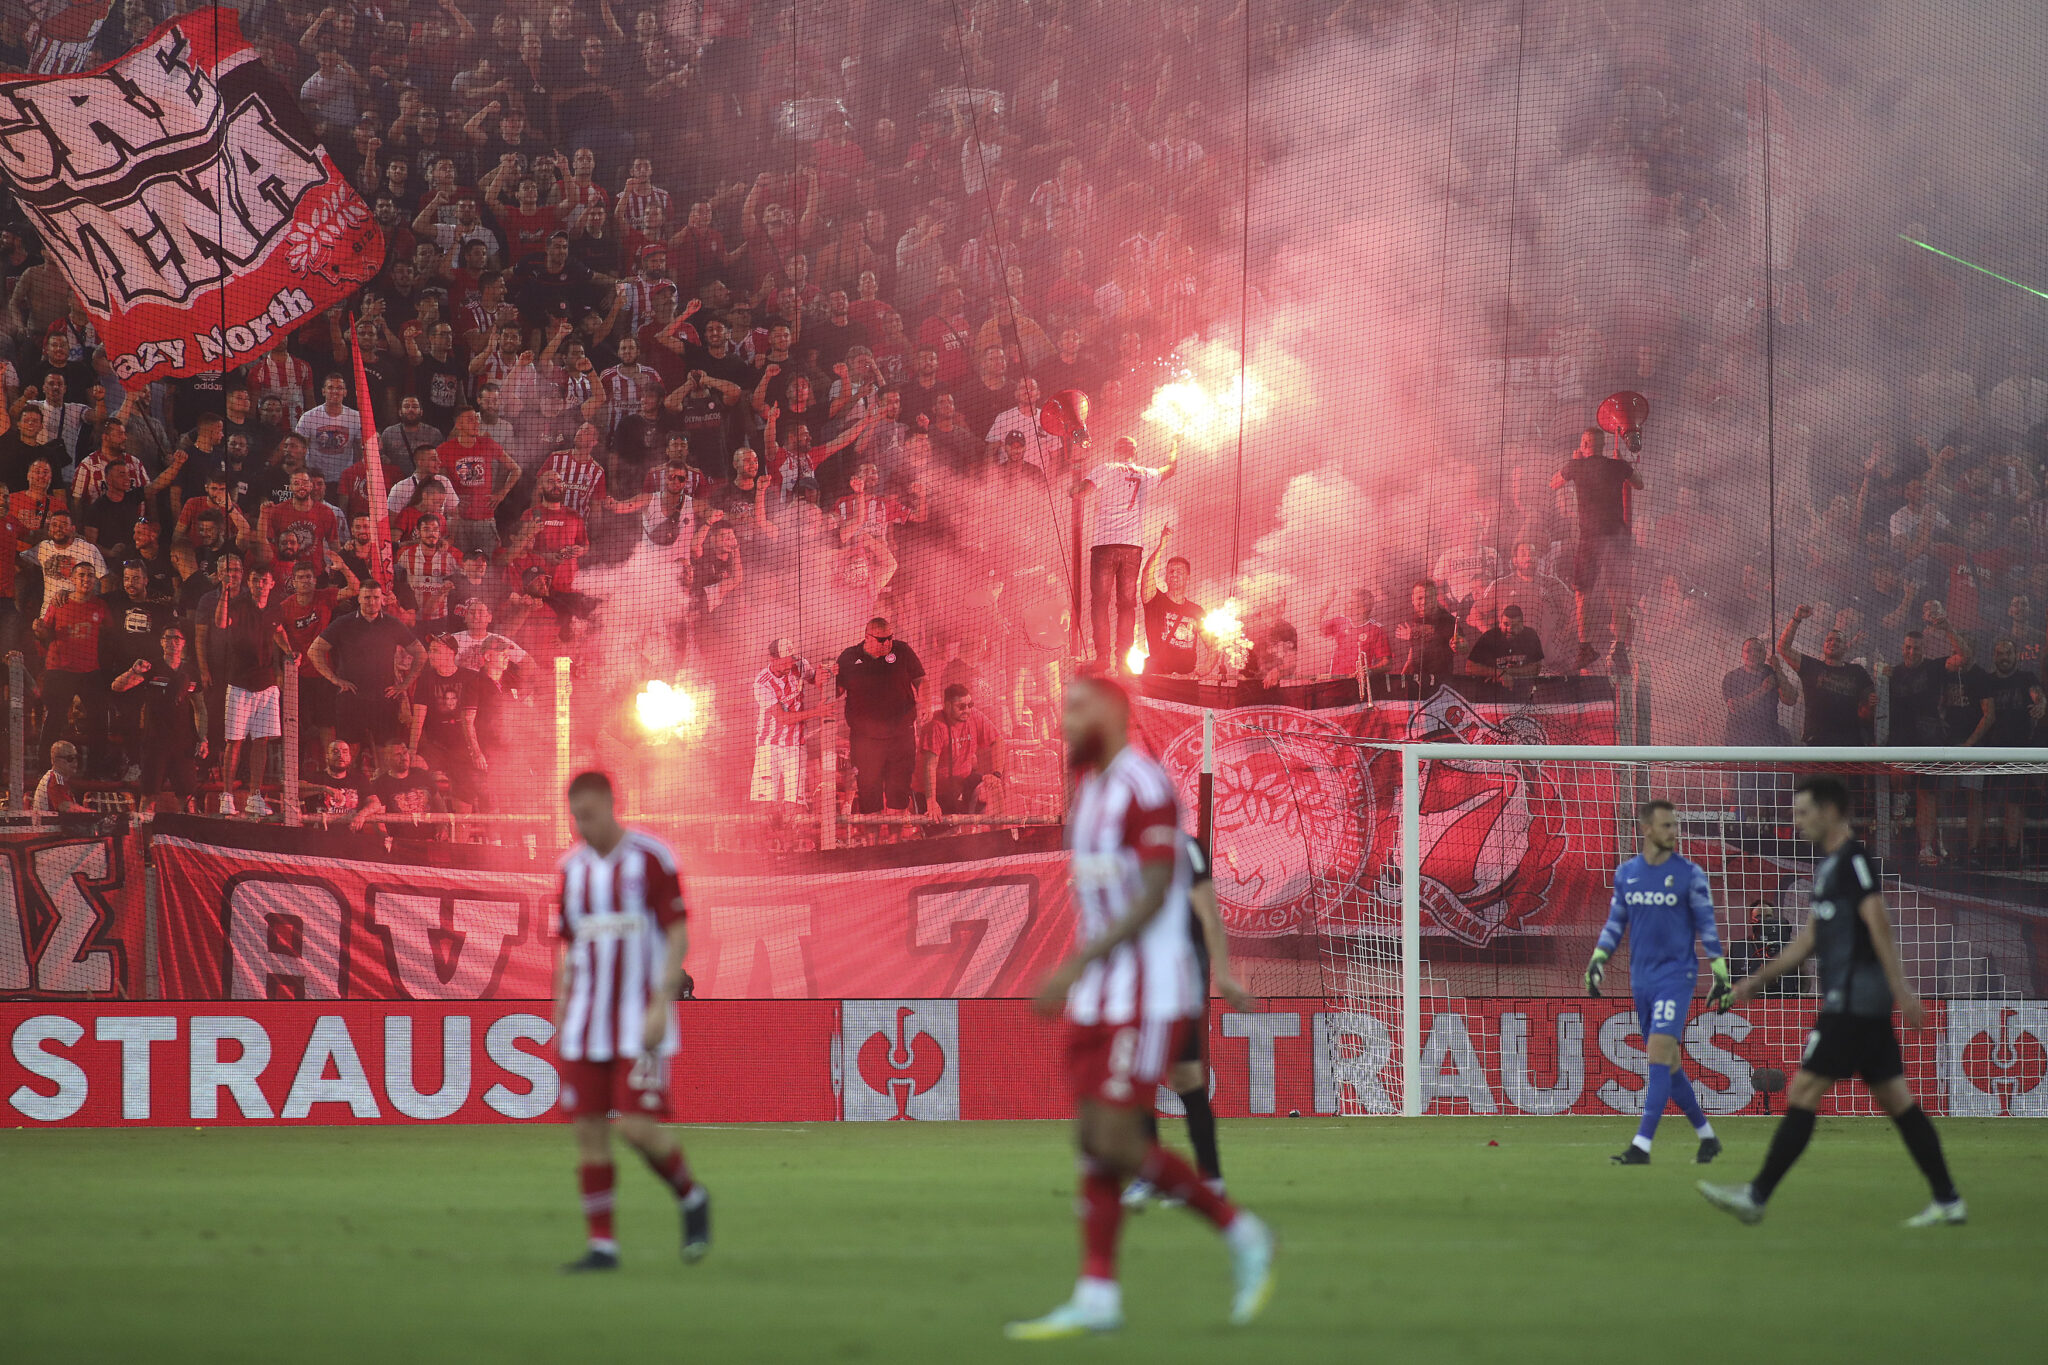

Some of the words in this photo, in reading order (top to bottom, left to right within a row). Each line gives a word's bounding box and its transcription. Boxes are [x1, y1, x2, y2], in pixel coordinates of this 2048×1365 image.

[194, 286, 315, 364] North
[193, 381, 224, 392] adidas
[272, 489, 294, 499] NORT
[1124, 477, 1142, 512] 7
[1624, 891, 1678, 907] CAZOO
[914, 883, 1030, 998] 7
[1653, 999, 1677, 1022] 26
[9, 1012, 622, 1122] STRAUS
